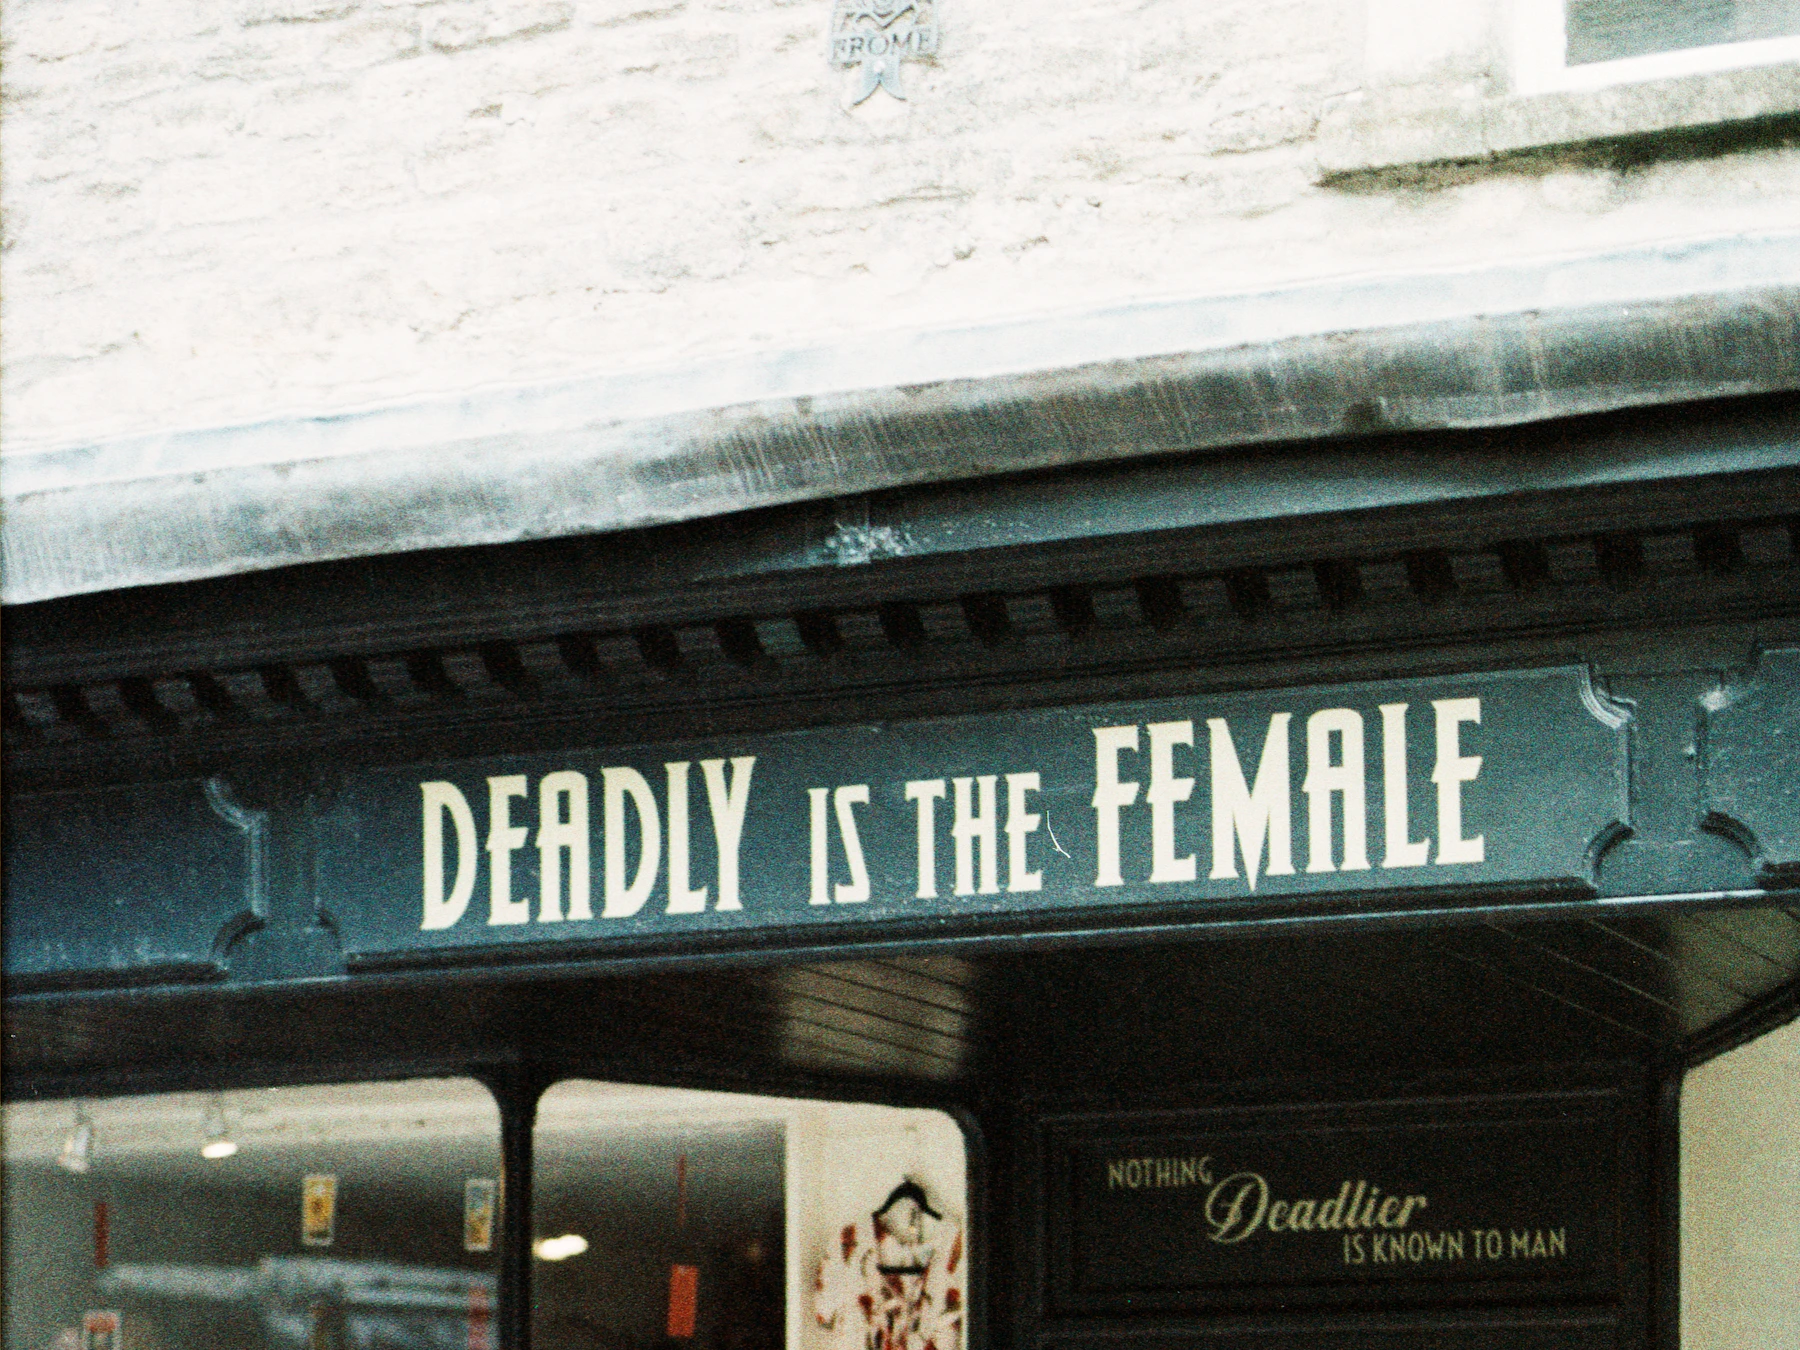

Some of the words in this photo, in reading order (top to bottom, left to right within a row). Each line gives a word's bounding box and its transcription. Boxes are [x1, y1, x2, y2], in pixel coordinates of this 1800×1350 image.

[834, 30, 936, 58] FROME
[420, 757, 755, 931] DEADLY
[809, 784, 871, 906] IS
[905, 772, 1043, 900] THE
[1092, 698, 1486, 892] FEMALE
[1107, 1156, 1214, 1189] NOTHING
[1204, 1171, 1429, 1243] Deadlier
[1343, 1232, 1366, 1265] IS
[1372, 1231, 1465, 1264] KNOWN
[1473, 1229, 1502, 1260] TO
[1510, 1227, 1567, 1259] MAN
